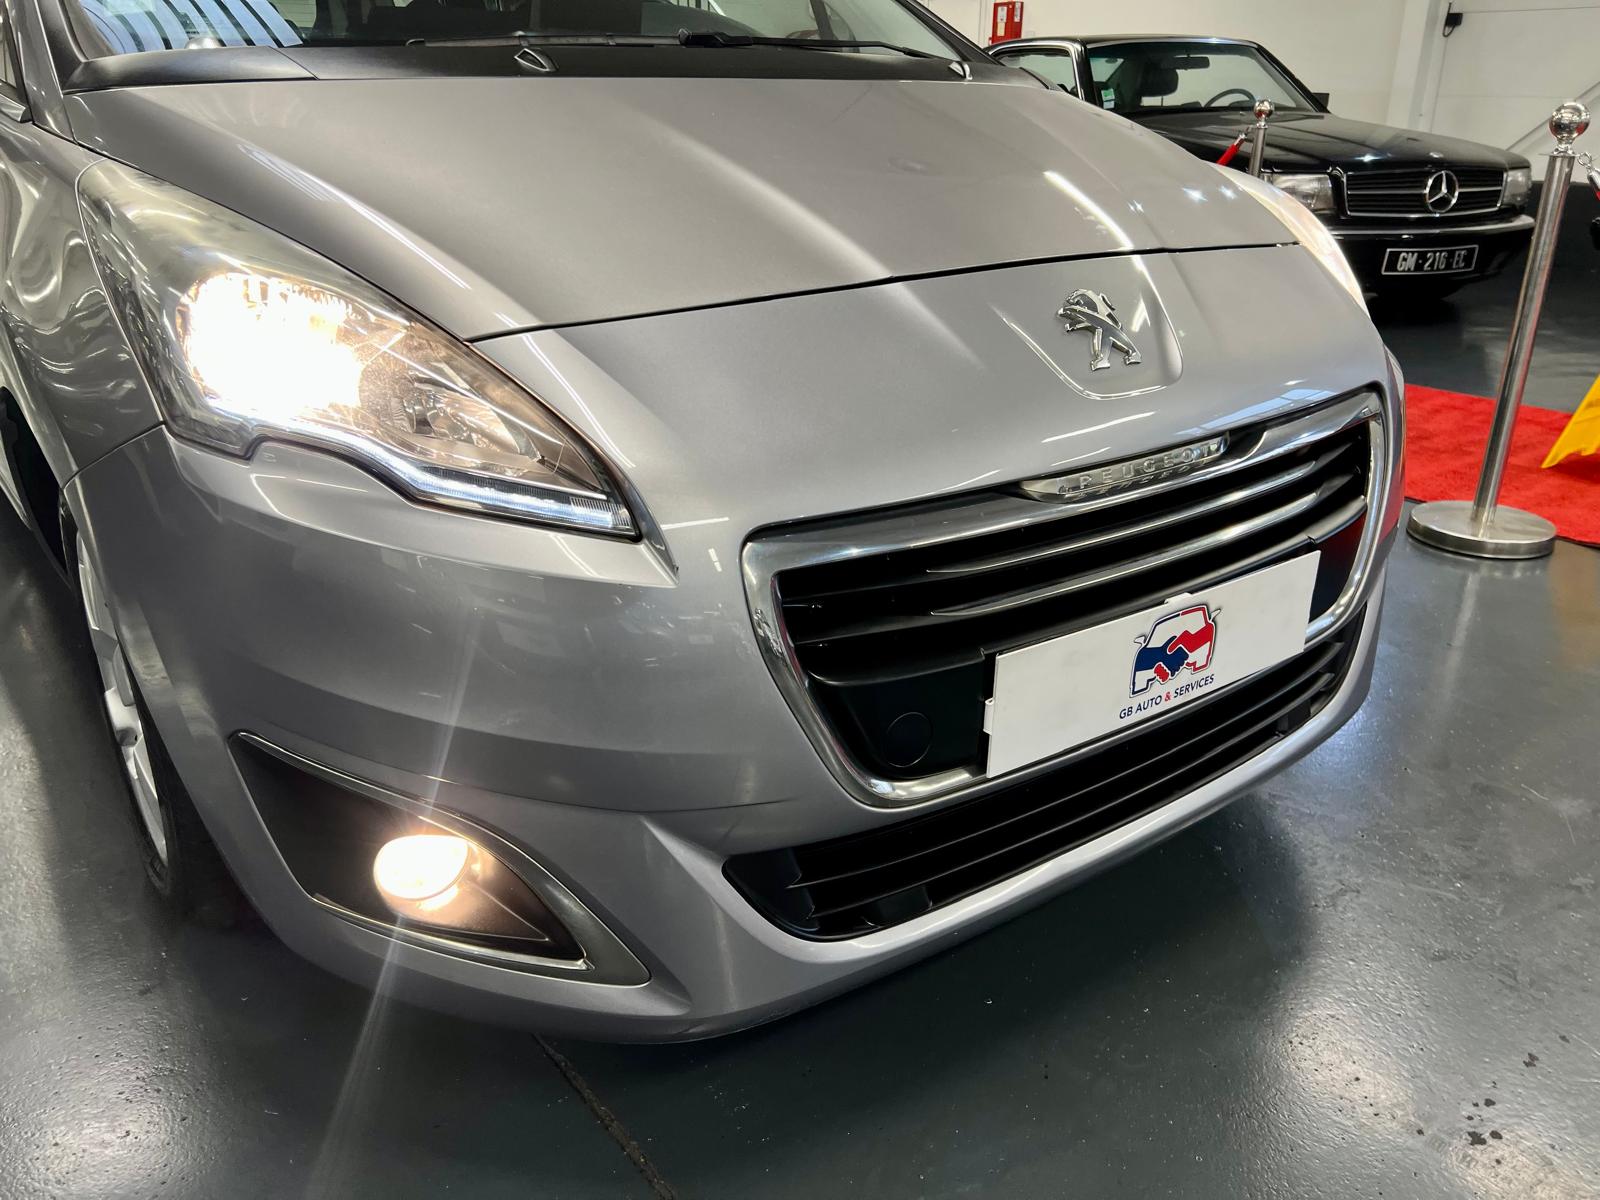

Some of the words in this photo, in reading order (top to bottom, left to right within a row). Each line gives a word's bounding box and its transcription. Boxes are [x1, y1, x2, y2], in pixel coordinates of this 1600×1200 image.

[1079, 444, 1211, 489] PEUGEOT
[1119, 706, 1133, 719] GB
[1135, 695, 1163, 714] AUTO
[1164, 691, 1172, 702] &
[1173, 674, 1215, 698] SERVICES
